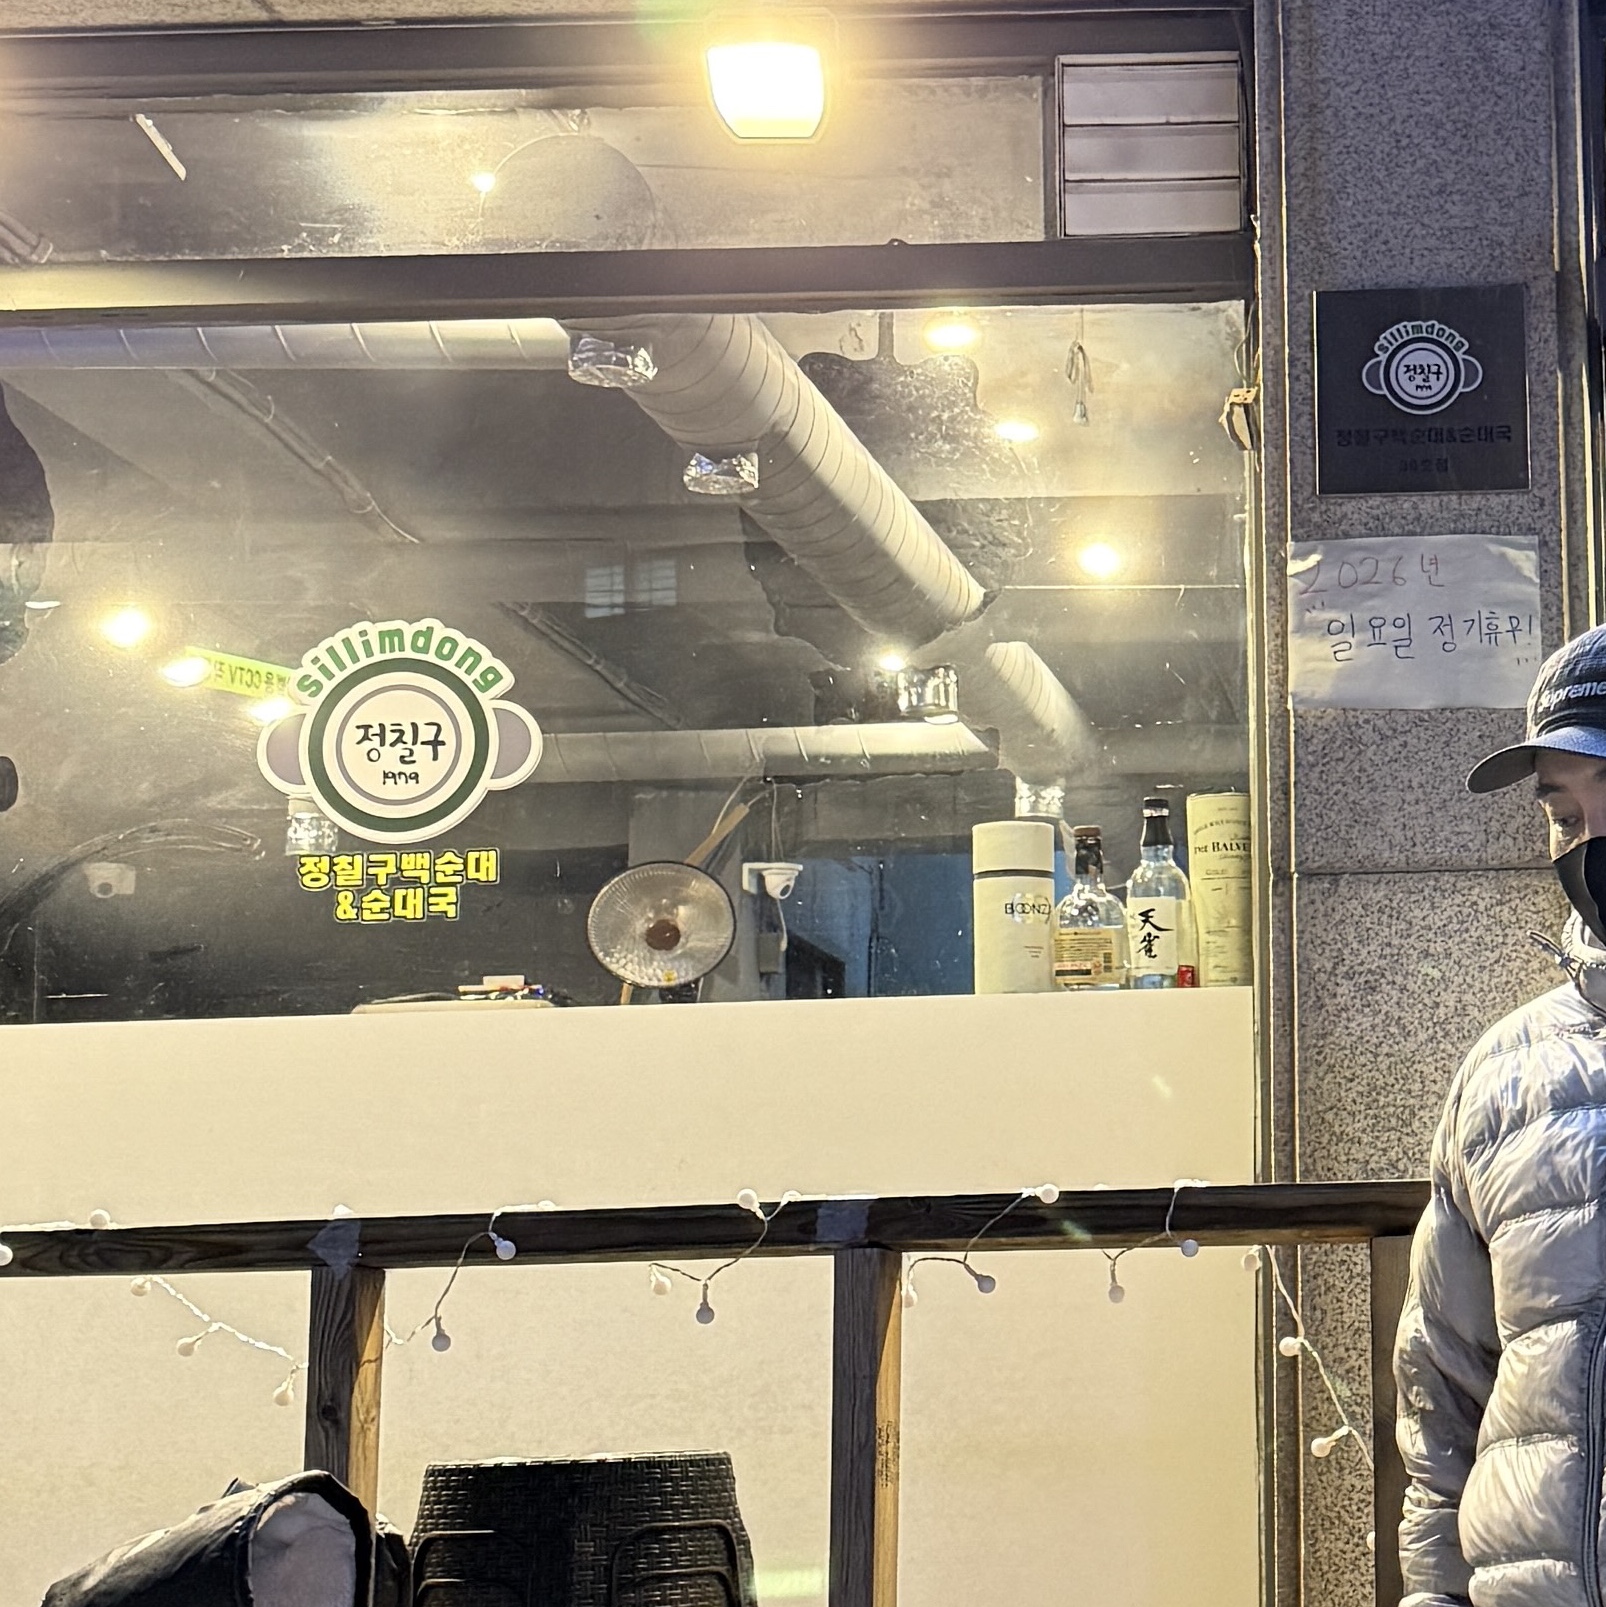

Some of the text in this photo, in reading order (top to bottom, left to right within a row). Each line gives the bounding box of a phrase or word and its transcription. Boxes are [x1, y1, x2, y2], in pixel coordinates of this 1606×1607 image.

[1377, 323, 1467, 355] sillimdong
[1404, 363, 1444, 383] 정칠구
[1327, 611, 1416, 663] 일요일
[297, 626, 504, 698] sillimdong
[355, 721, 447, 764] 정칠구
[383, 770, 420, 785] 1979
[298, 848, 499, 889] 정칠구백순대
[334, 886, 460, 922] &순대국
